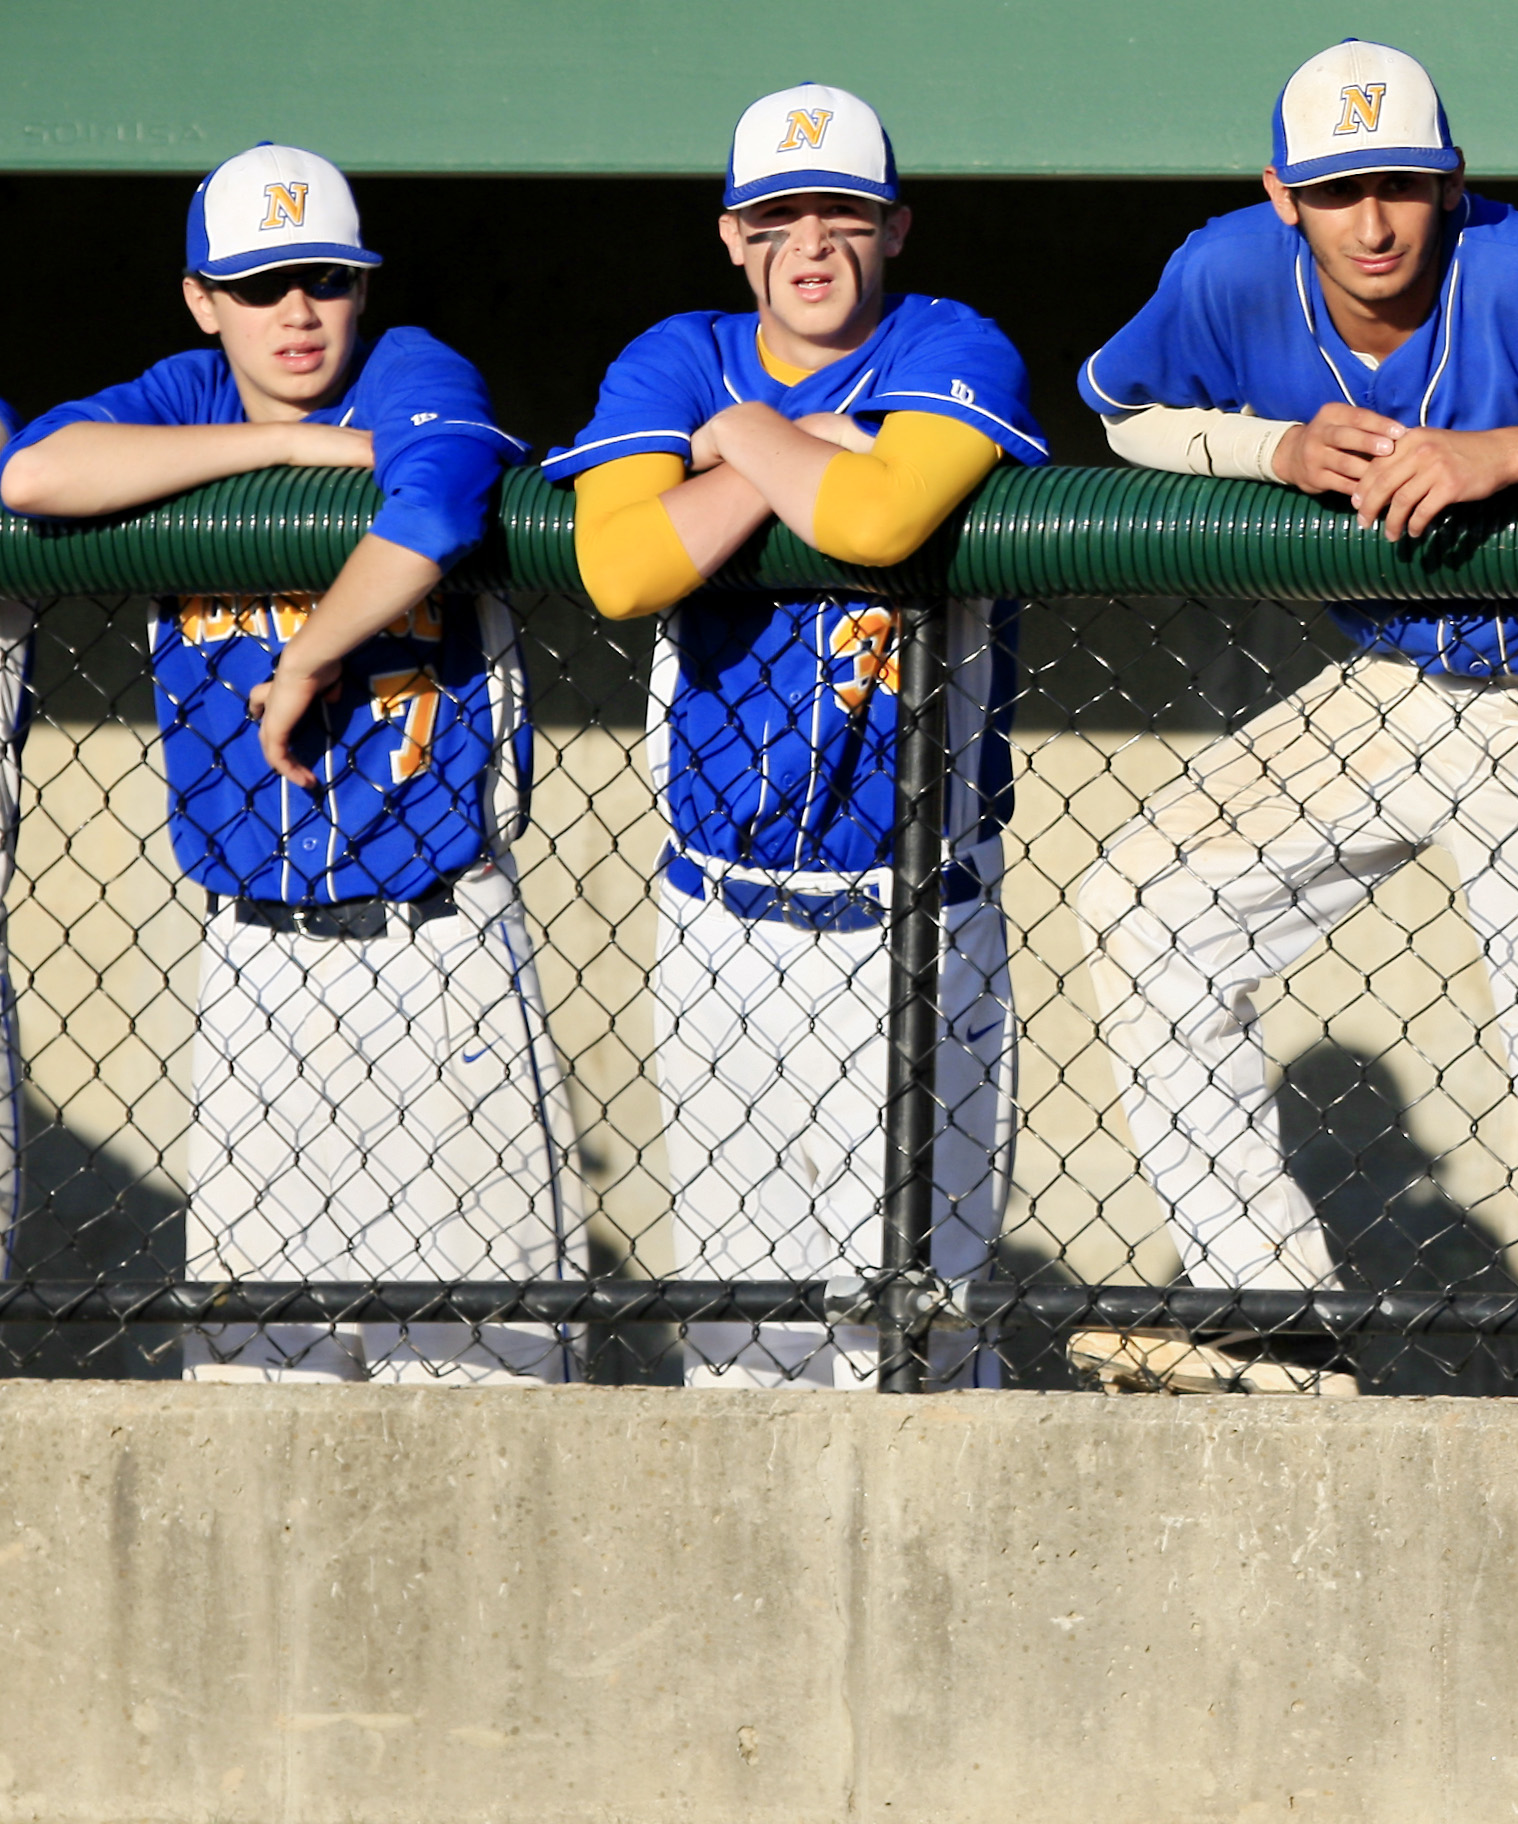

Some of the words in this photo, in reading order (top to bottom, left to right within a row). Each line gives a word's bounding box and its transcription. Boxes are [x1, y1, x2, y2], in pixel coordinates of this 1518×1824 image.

[777, 108, 832, 153] N
[1333, 82, 1387, 136] N
[258, 181, 308, 231] N
[369, 664, 440, 785] 7
